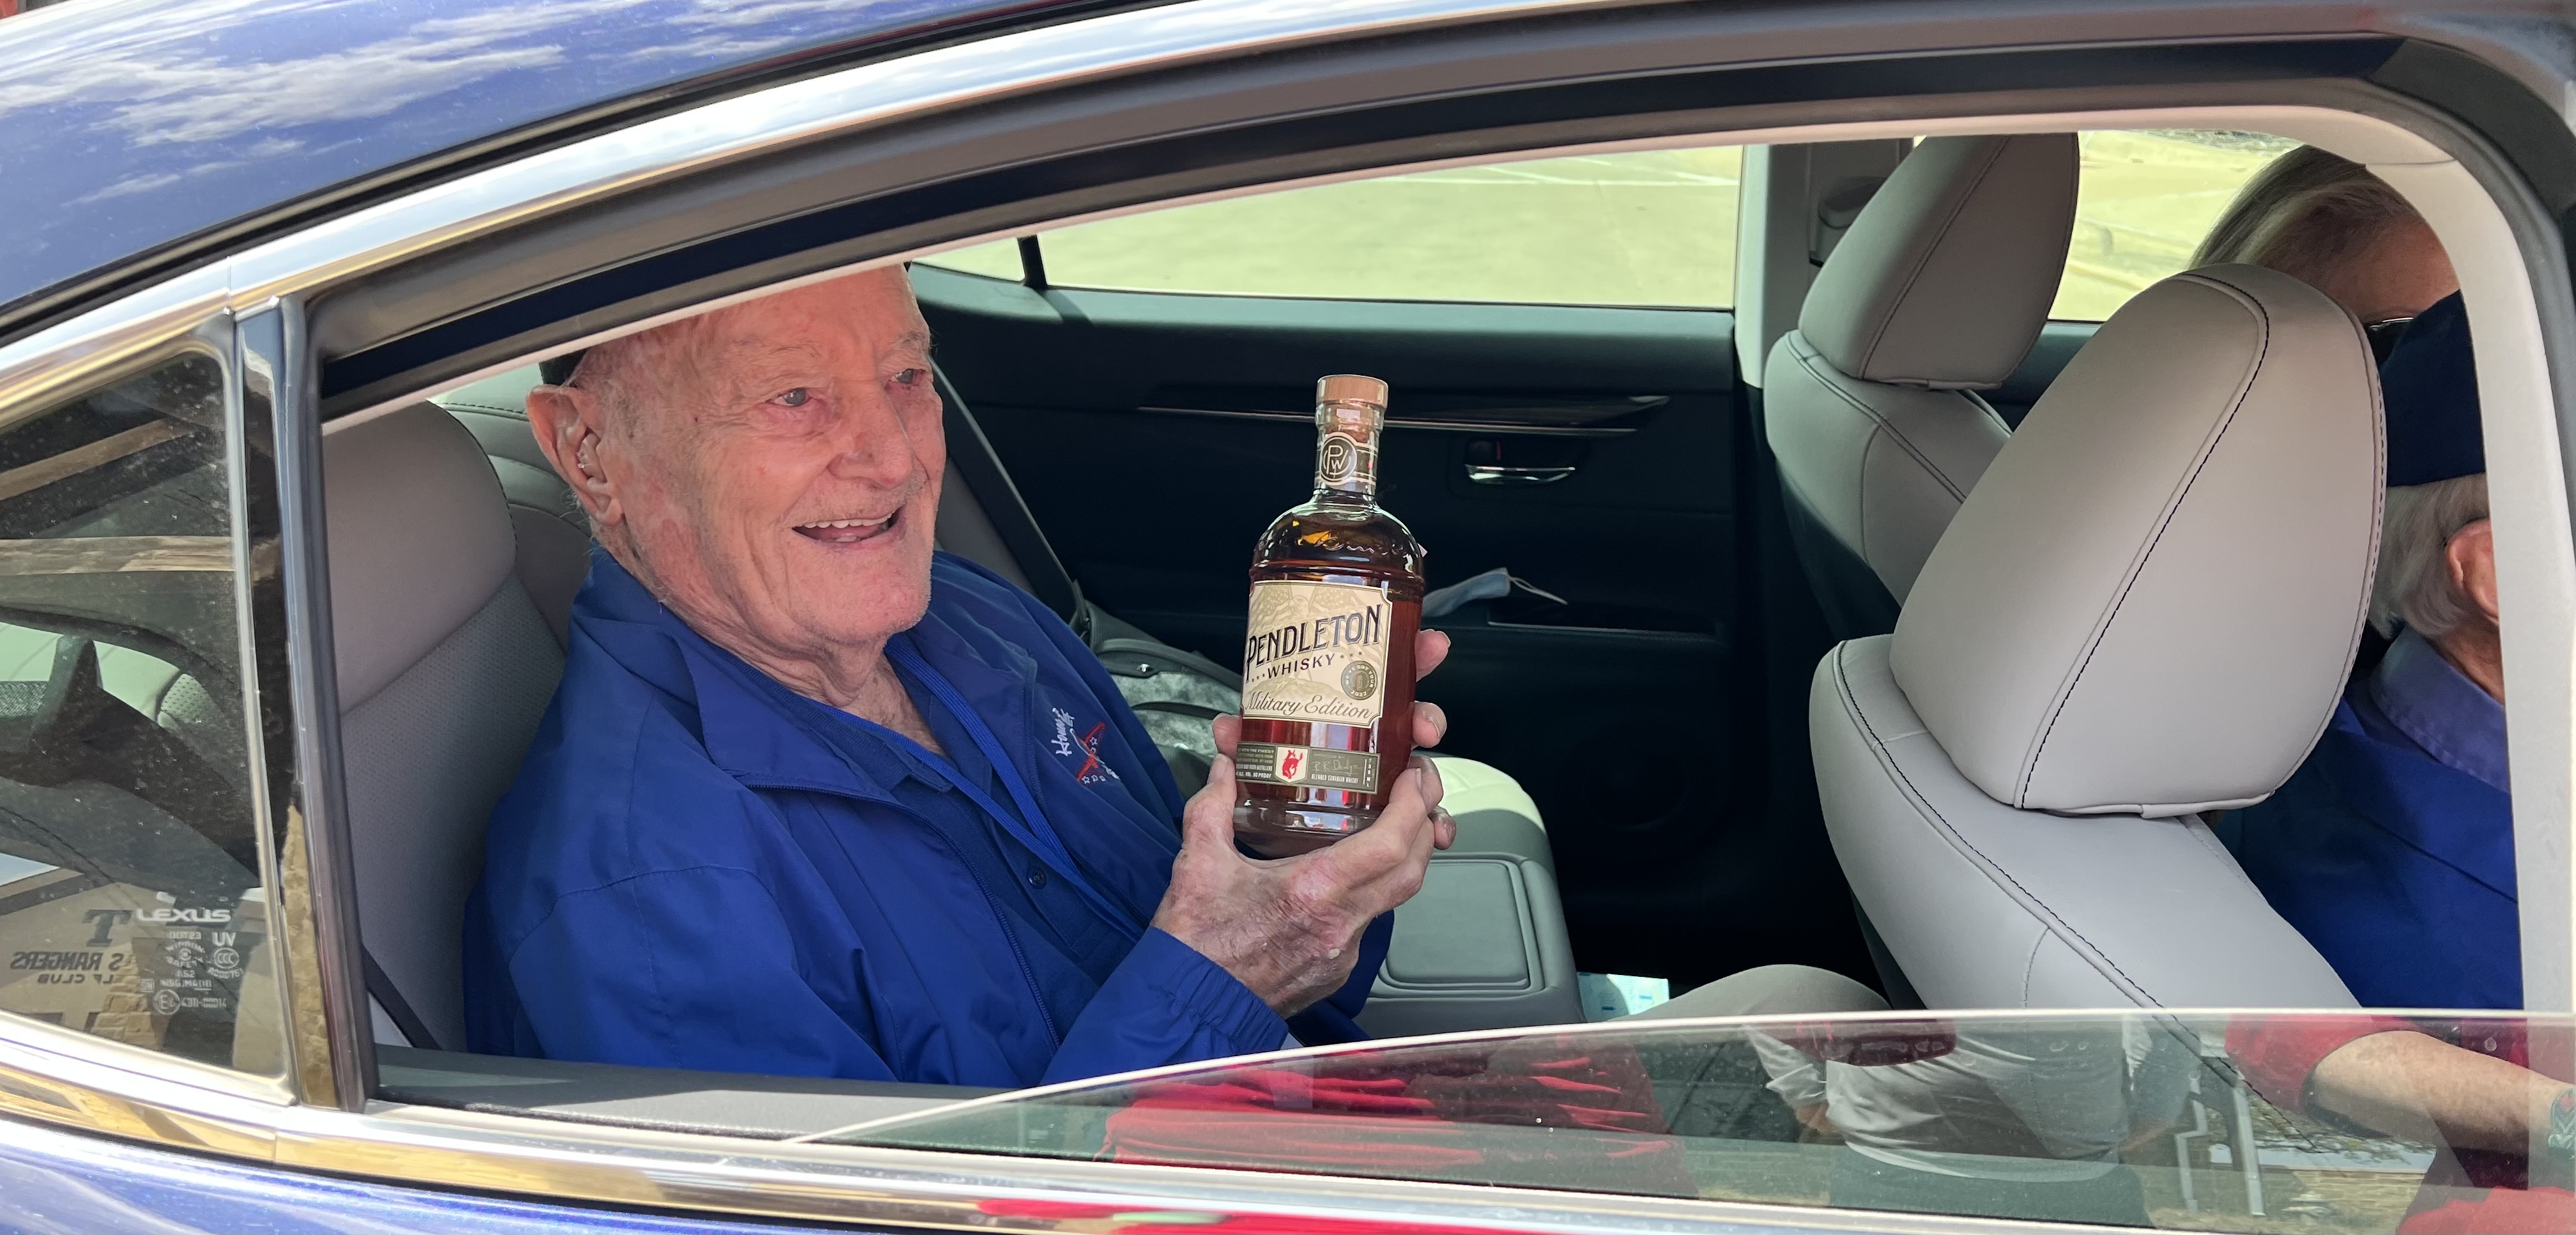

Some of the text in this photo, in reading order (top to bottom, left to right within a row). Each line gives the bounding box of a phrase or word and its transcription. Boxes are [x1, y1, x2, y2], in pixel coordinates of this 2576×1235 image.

[1246, 604, 1383, 684] PENDLETON
[1268, 653, 1338, 679] WHISKY
[1246, 691, 1373, 719] Military Edition
[135, 909, 231, 923] LEXUS
[211, 932, 236, 947] UV
